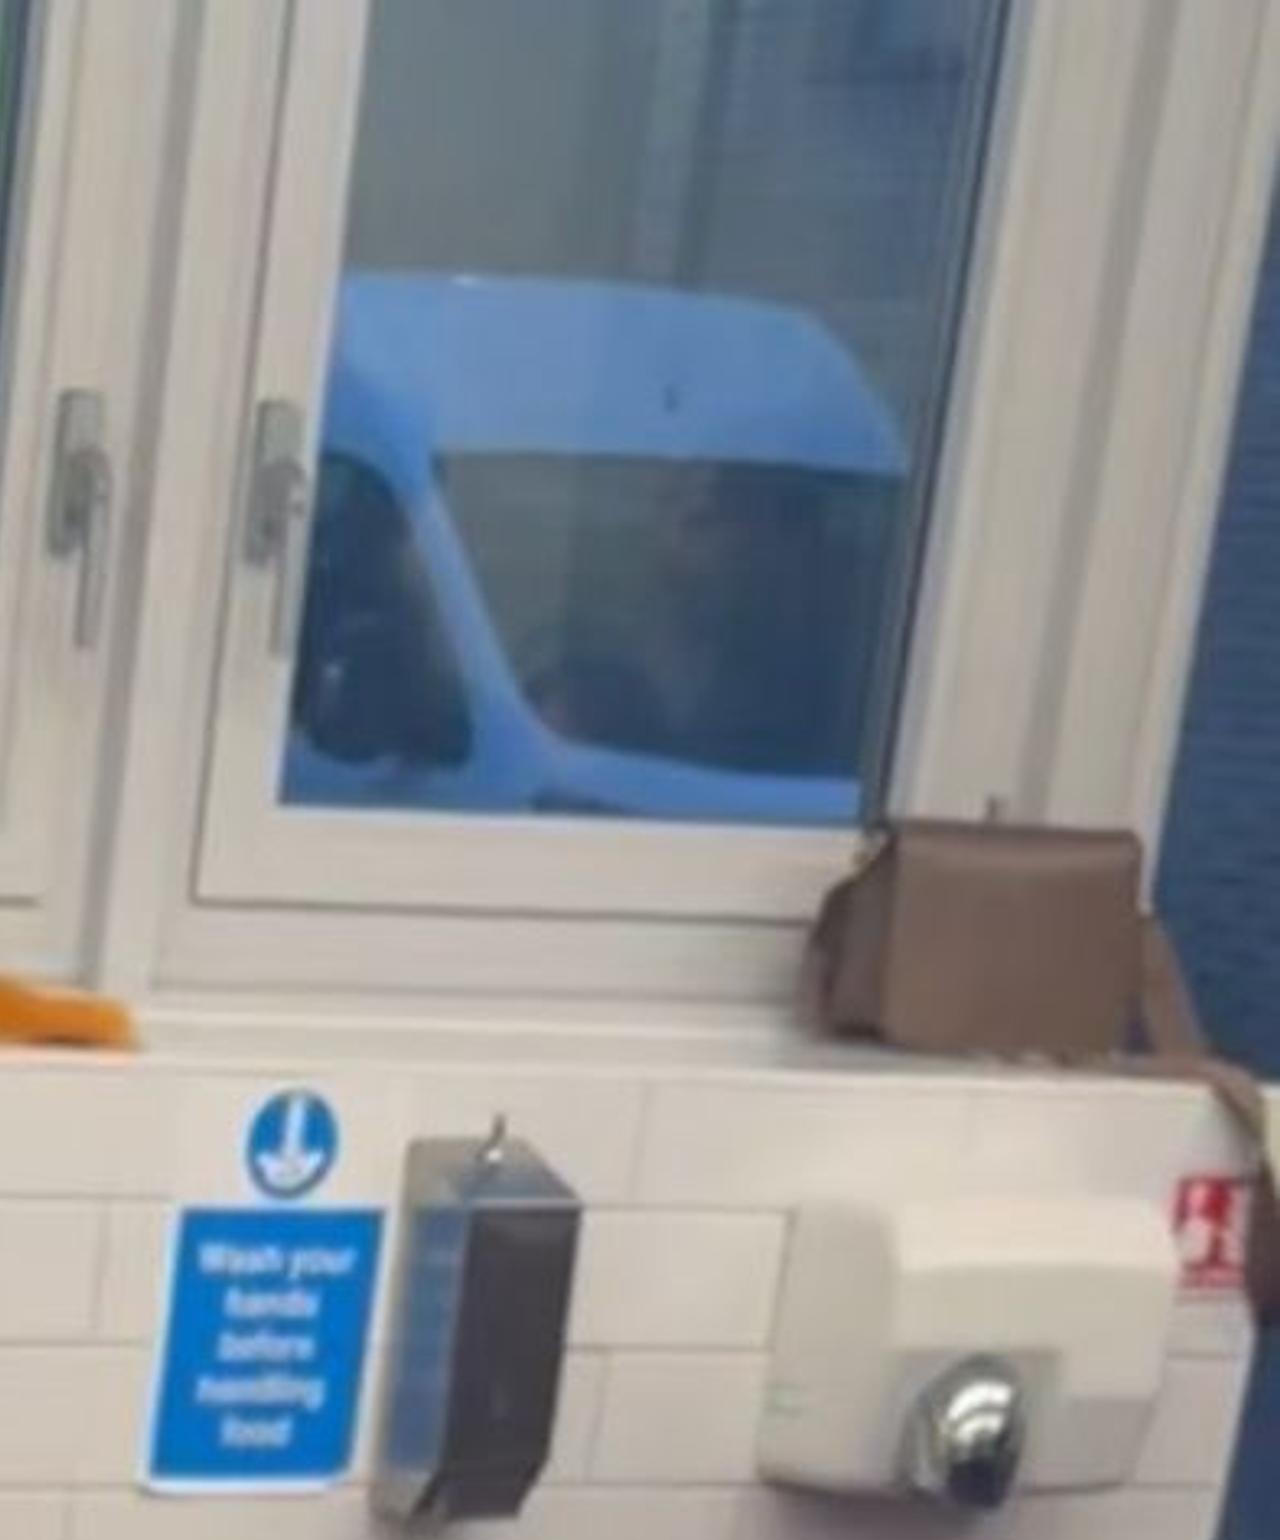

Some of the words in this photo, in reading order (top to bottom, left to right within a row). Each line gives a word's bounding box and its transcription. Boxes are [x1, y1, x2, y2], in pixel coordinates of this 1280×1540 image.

[199, 1243, 282, 1274] Wash
[289, 1246, 358, 1281] your
[224, 1286, 320, 1319] hands
[219, 1331, 316, 1362] before
